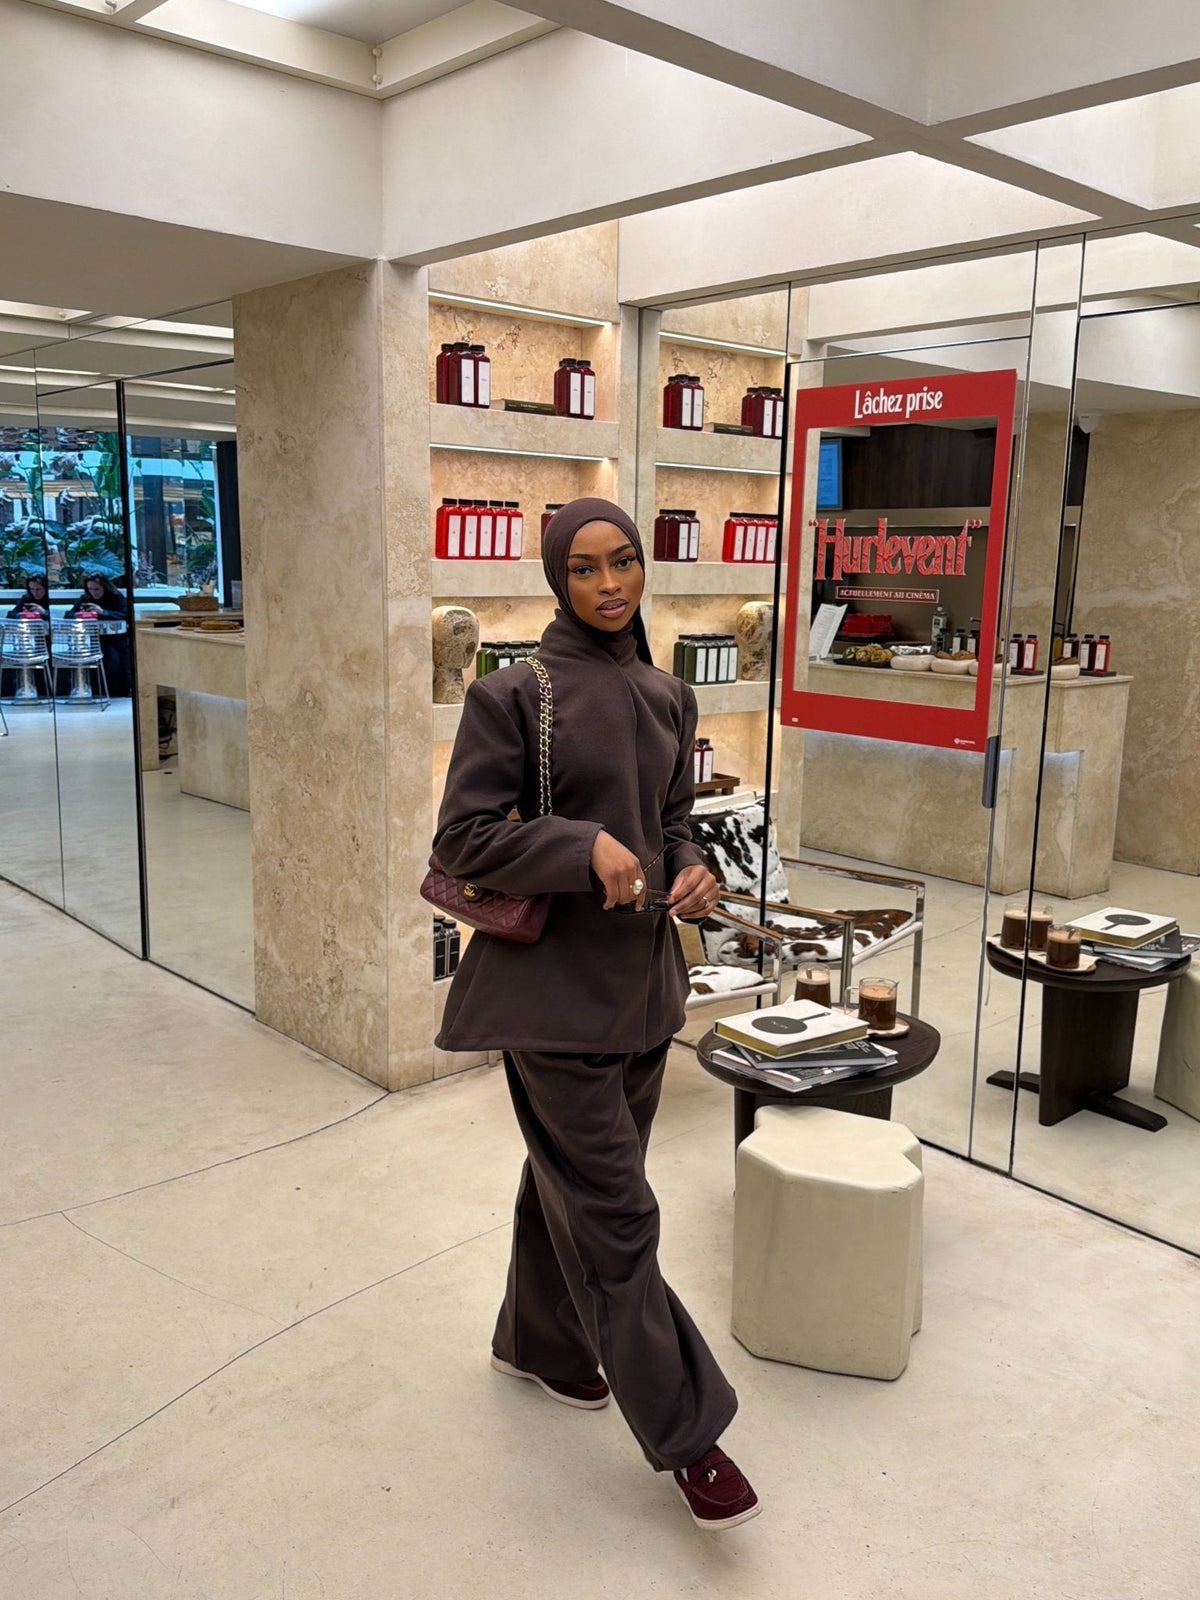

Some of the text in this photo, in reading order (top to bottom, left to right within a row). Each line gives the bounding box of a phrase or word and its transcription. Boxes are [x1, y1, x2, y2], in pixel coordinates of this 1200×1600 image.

[854, 386, 943, 419] Lâchez prise
[839, 589, 936, 600] ACTUELLEMENT AU CINÉMA
